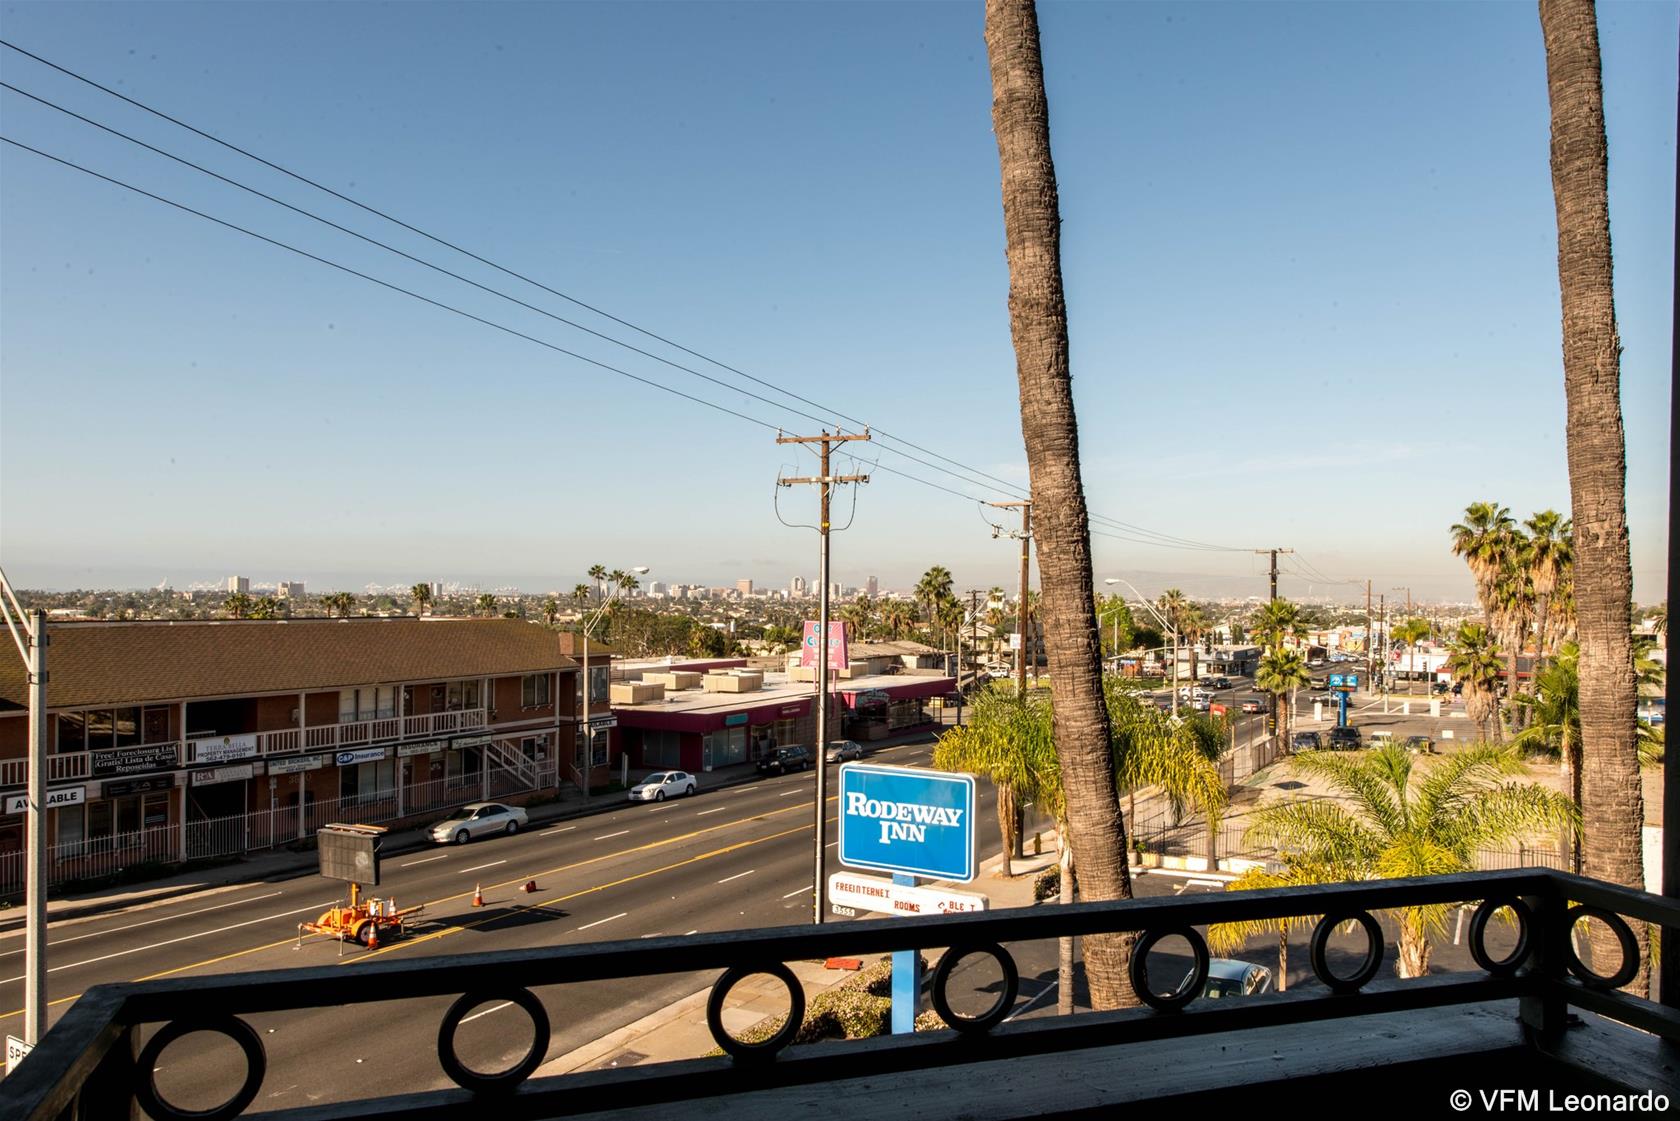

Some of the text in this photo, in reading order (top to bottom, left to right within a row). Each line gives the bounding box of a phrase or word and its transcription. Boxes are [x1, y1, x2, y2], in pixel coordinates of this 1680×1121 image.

[95, 752, 115, 760] Free!
[117, 748, 160, 758] Foreclosure
[197, 746, 254, 758] PROPERTY MANAGEMENT
[355, 751, 384, 760] Insurance
[125, 756, 144, 765] Lista
[144, 755, 154, 763] de
[878, 820, 927, 846] INN
[894, 900, 921, 913] ROOMS
